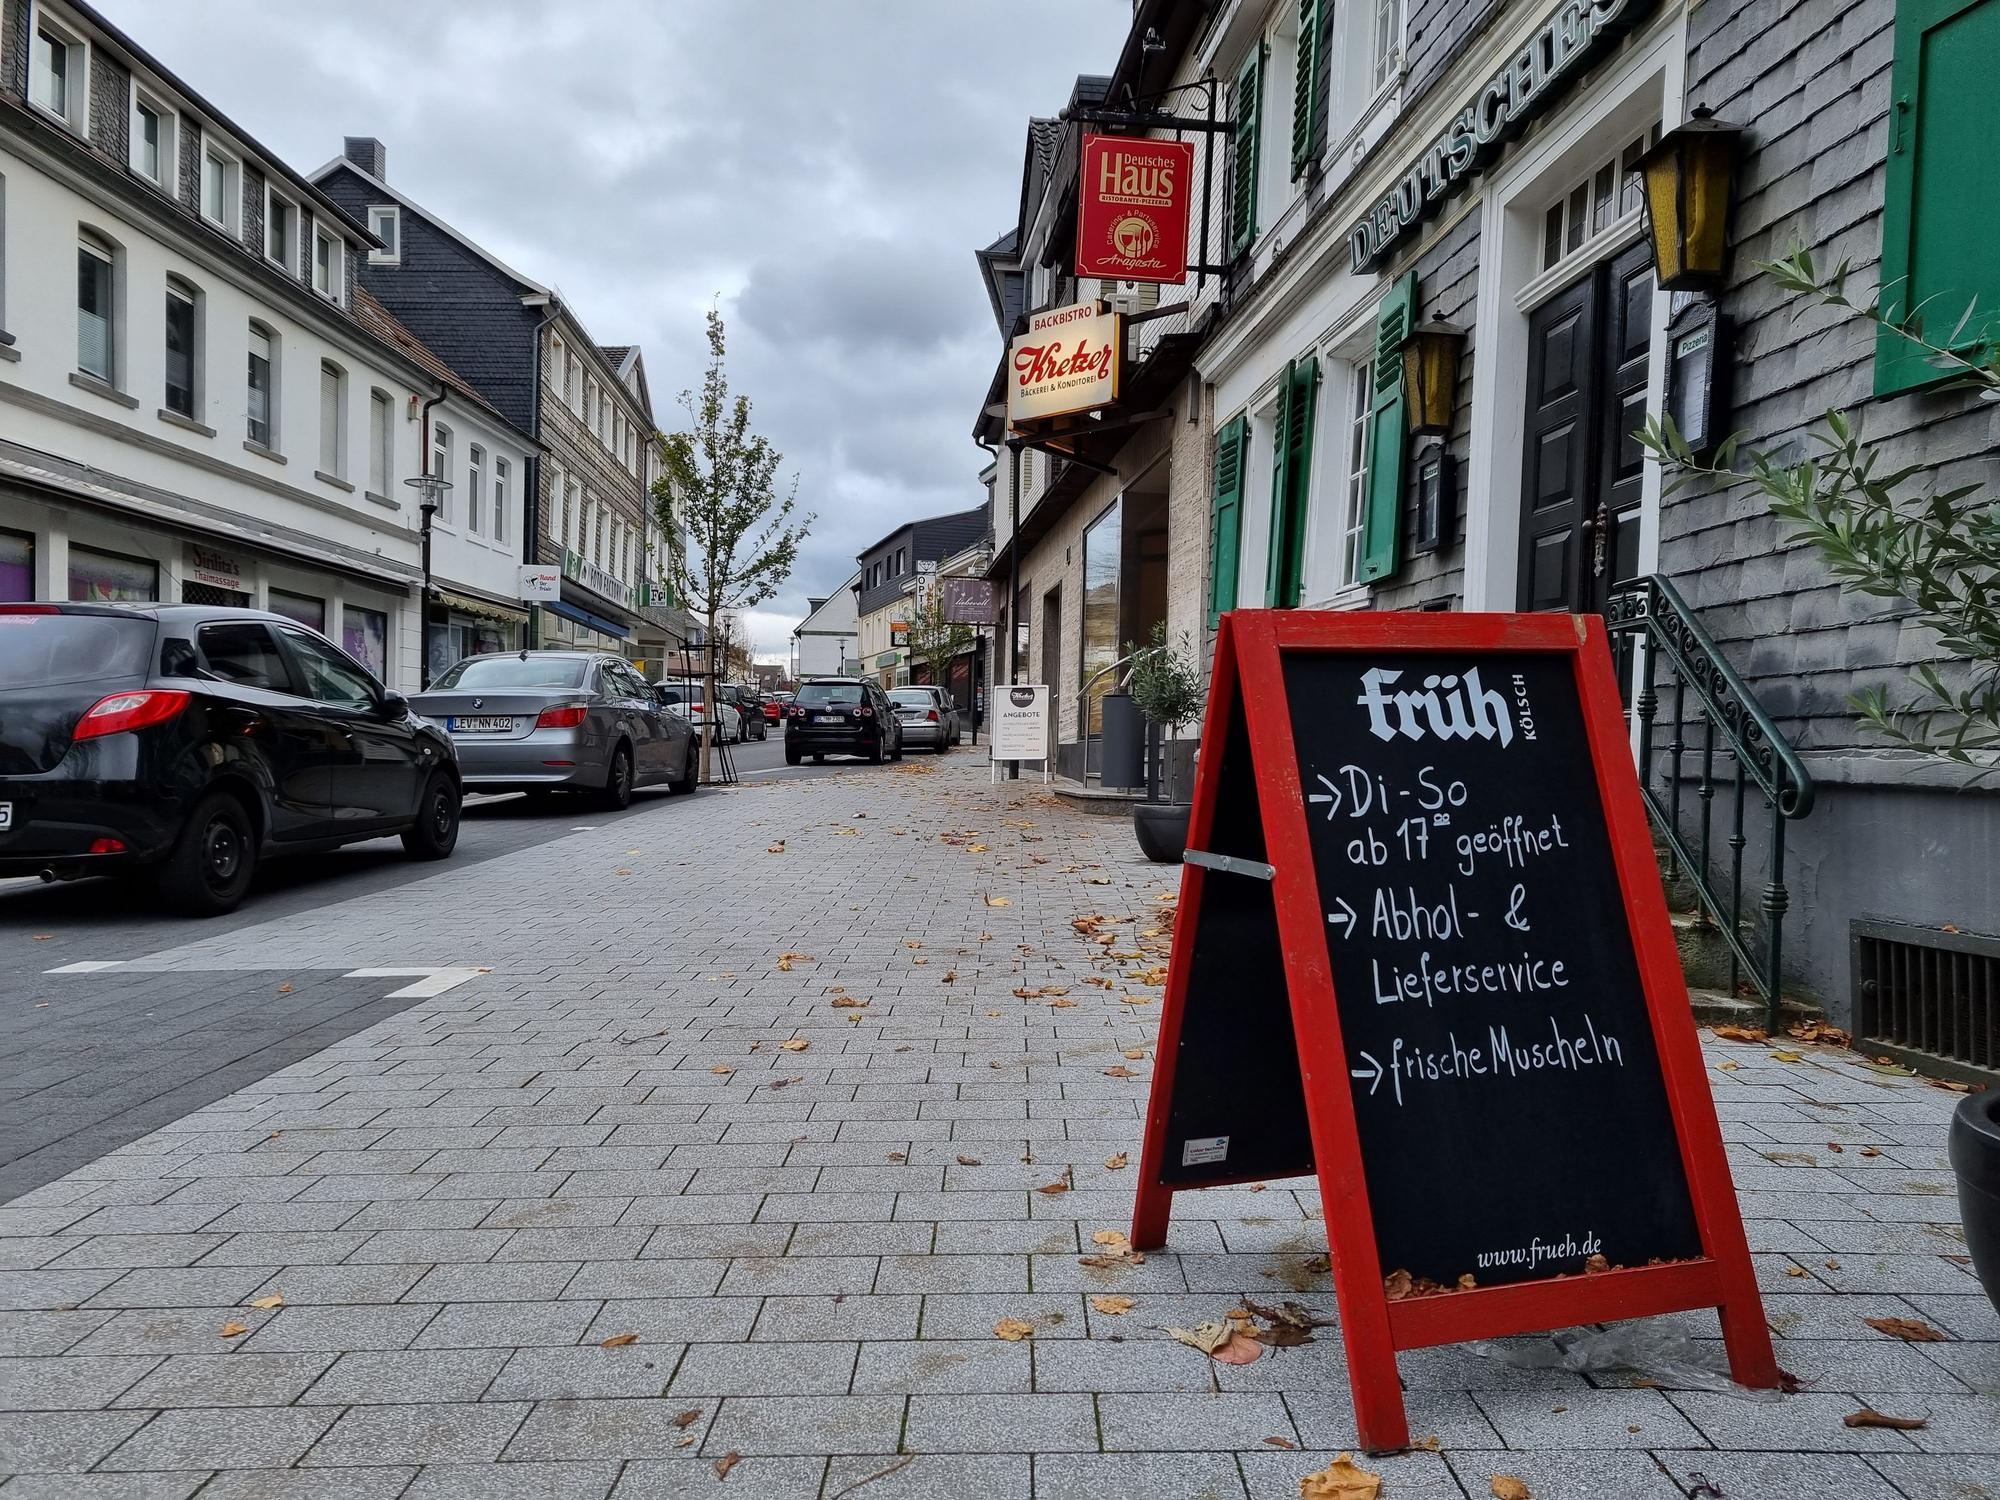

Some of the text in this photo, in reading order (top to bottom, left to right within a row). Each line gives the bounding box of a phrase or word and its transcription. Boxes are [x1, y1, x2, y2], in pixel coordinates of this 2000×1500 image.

[1100, 151, 1174, 198] Haus
[1124, 153, 1175, 168] Deutsches
[1133, 209, 1160, 249] Partyservice
[1096, 253, 1168, 271] Aragosta
[1034, 306, 1092, 331] BACKBISTRO
[1014, 338, 1112, 386] Kretzer
[1682, 332, 1708, 354] Pizzeria
[1050, 383, 1056, 392] &
[1057, 375, 1096, 390] KONDITOREI
[194, 569, 240, 589] Thaimassage
[590, 567, 602, 591] FOTO
[454, 717, 511, 729] LEV NN 402
[1511, 674, 1537, 740] KÖLSCH
[1347, 827, 1388, 866] ab
[1456, 813, 1569, 876] geöffnet
[1372, 883, 1530, 941] Abhol- &
[1372, 951, 1569, 1008] Lieferservice
[1390, 1013, 1623, 1107] frische Muscheln
[1477, 1230, 1602, 1270] www.frueh.de
